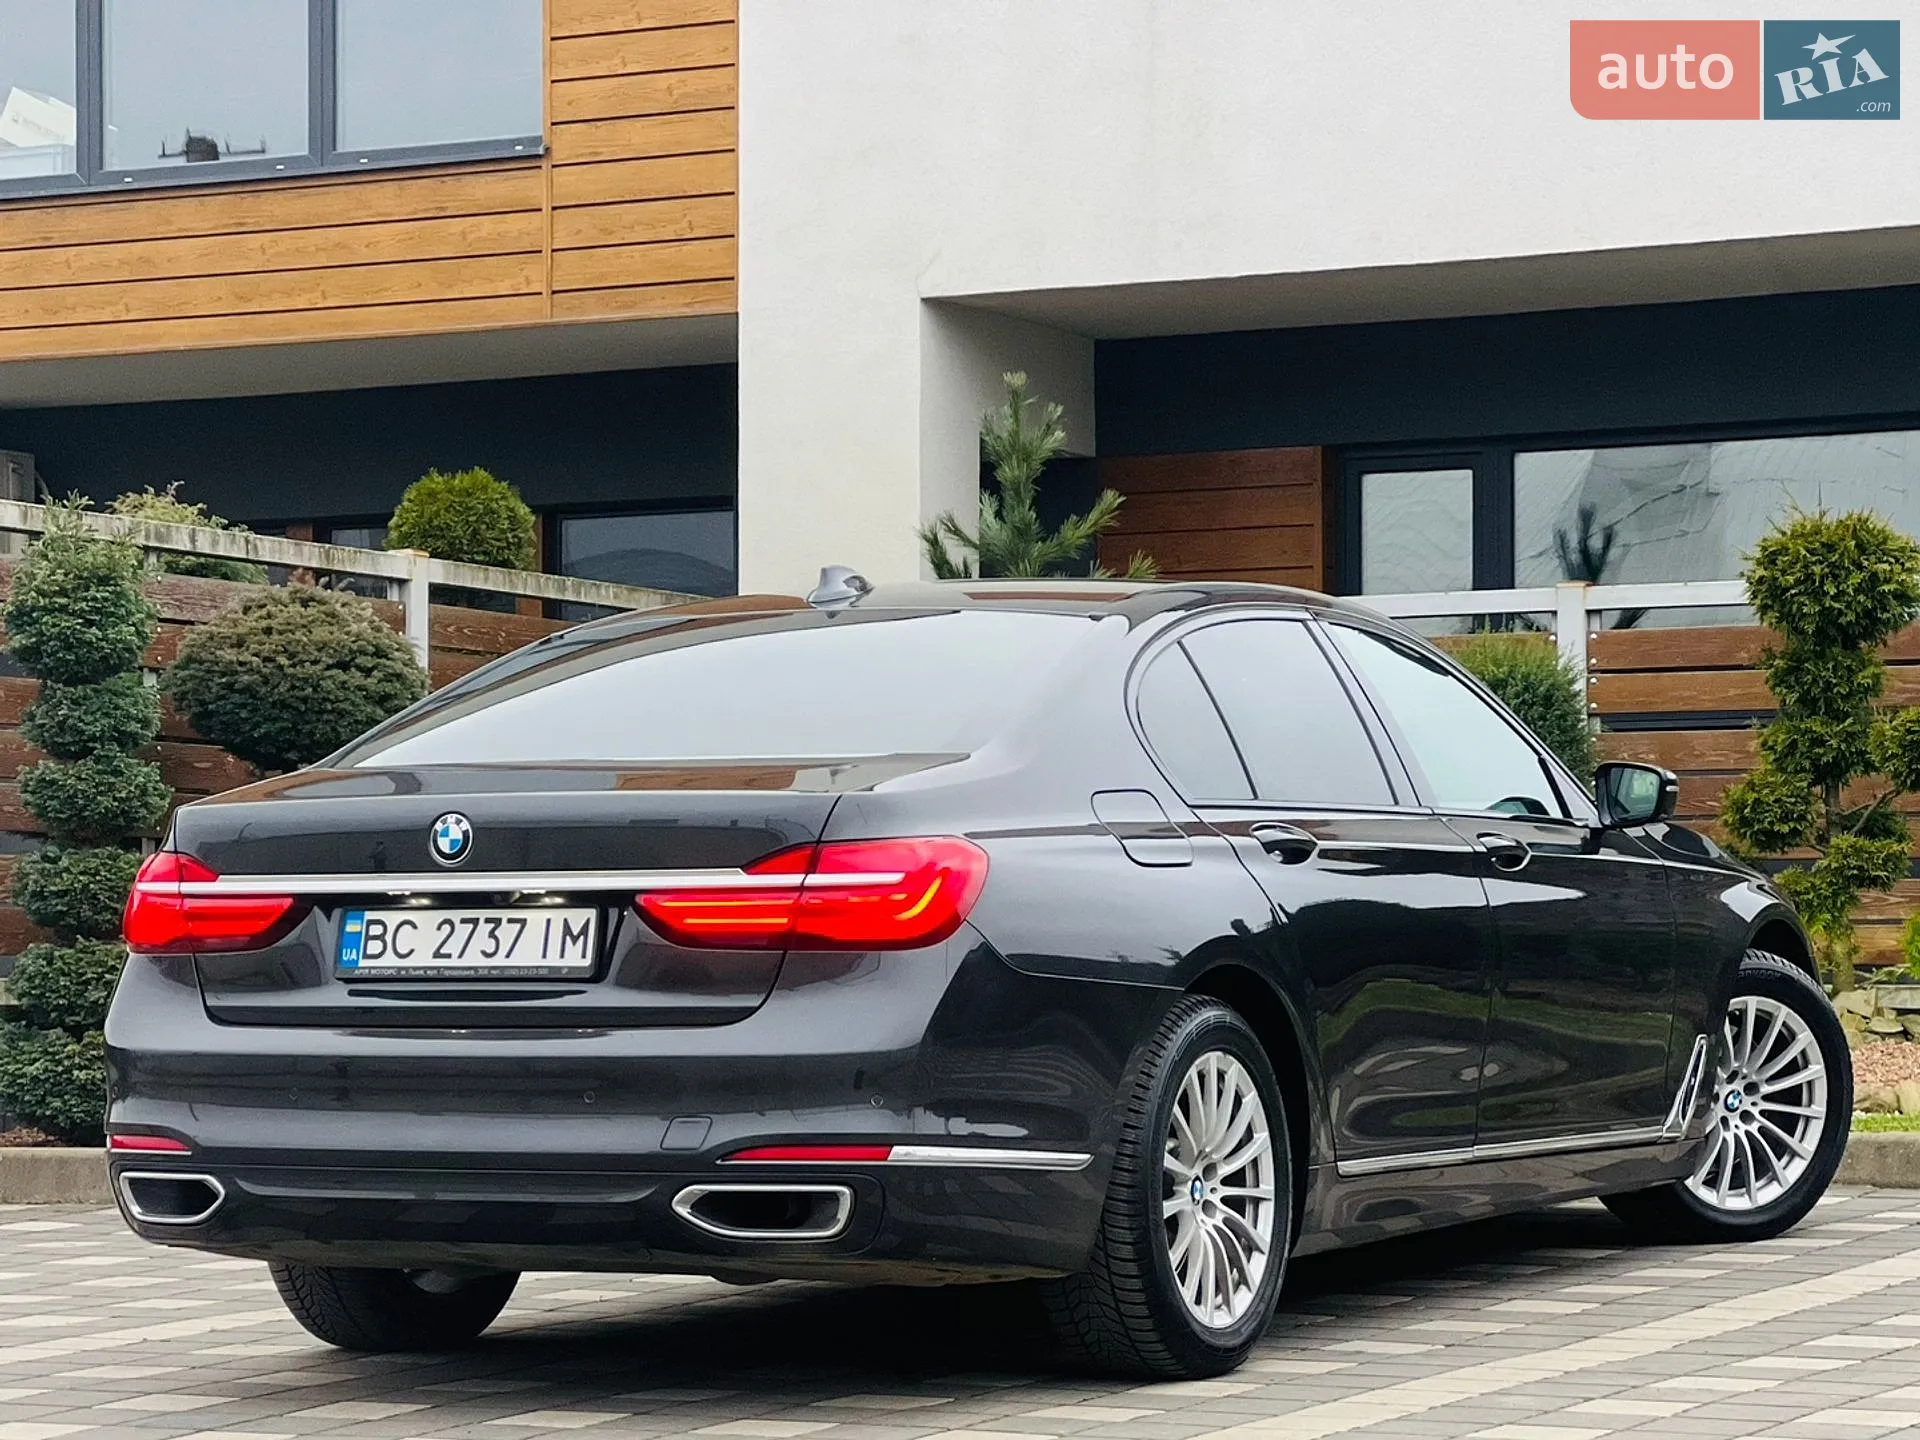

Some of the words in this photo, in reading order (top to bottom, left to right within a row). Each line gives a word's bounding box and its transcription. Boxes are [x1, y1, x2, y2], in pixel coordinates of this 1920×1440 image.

[435, 814, 469, 831] BMW
[362, 918, 418, 960] BC
[432, 917, 527, 960] 2737
[541, 917, 591, 960] IM
[342, 949, 358, 961] UA
